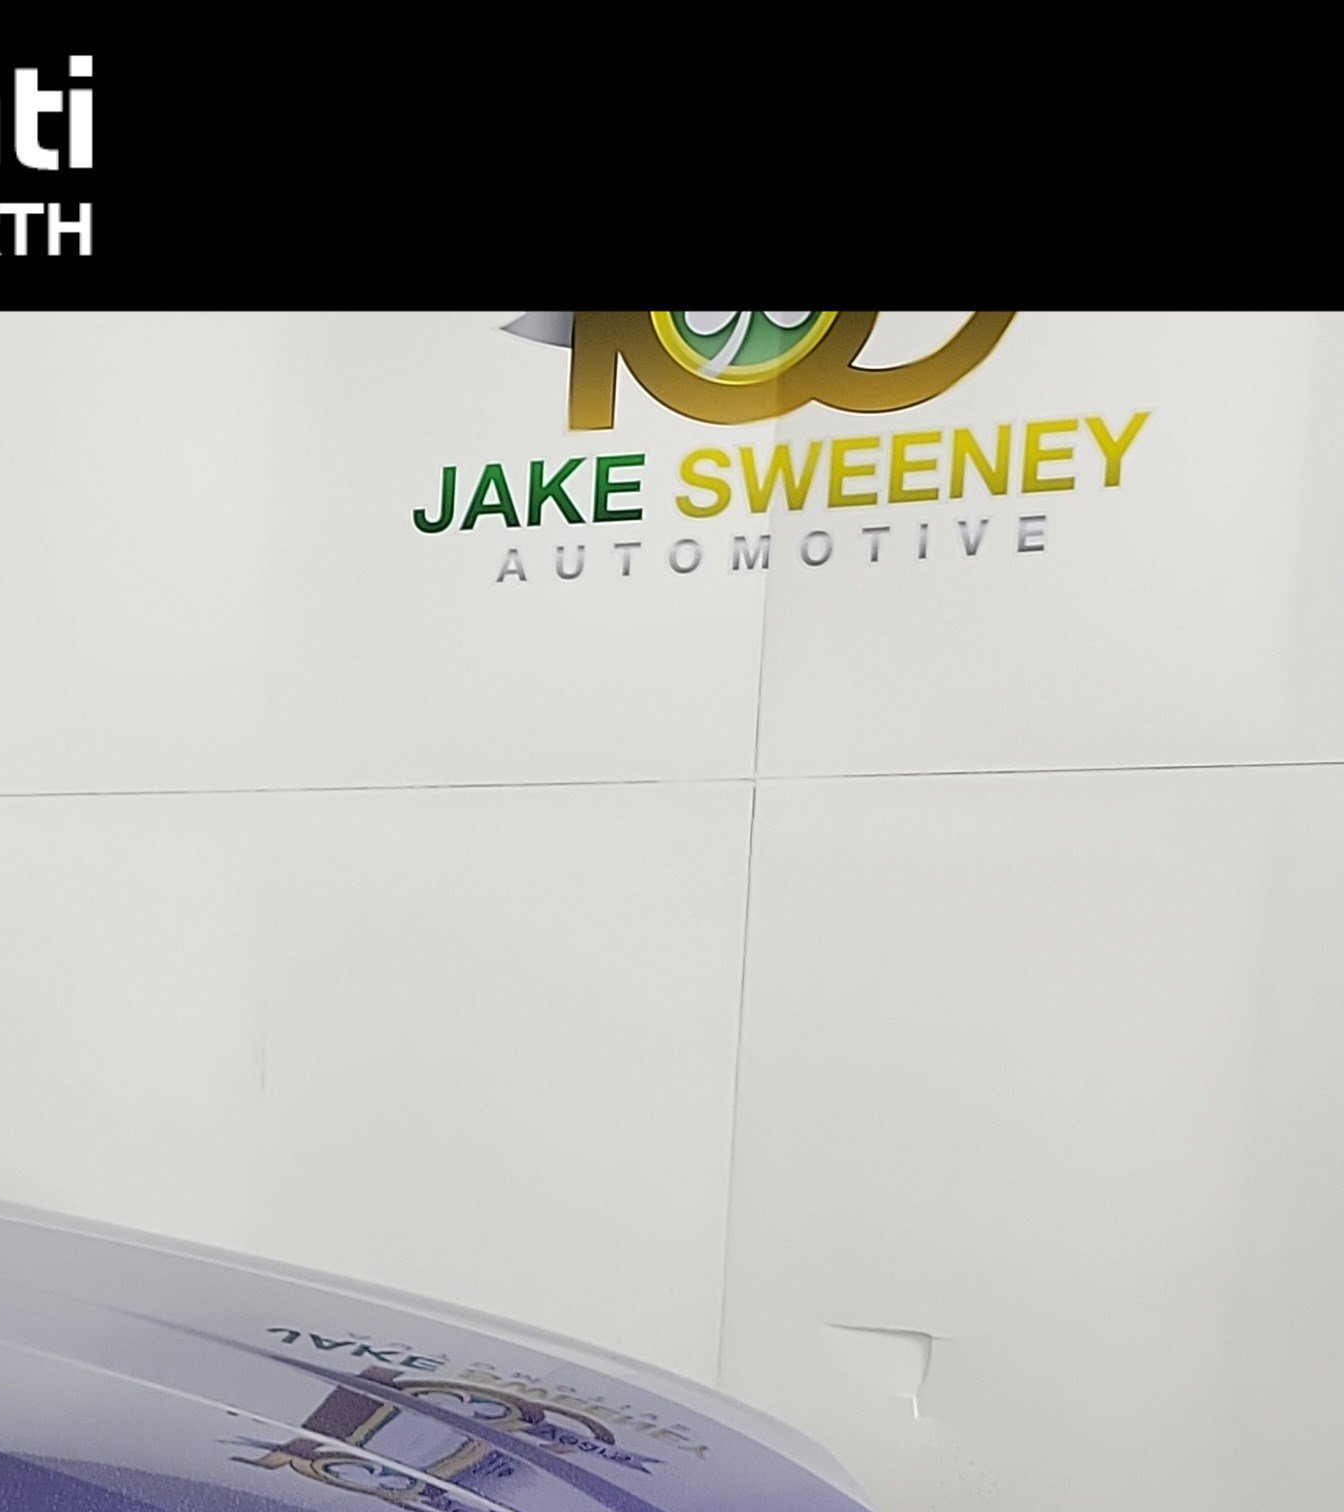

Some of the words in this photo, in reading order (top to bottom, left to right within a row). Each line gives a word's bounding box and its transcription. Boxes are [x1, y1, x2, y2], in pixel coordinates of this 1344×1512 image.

[412, 453, 647, 534] JAKE
[675, 411, 1150, 518] SWEENEY
[496, 515, 1048, 583] AUTOMOTIVE
